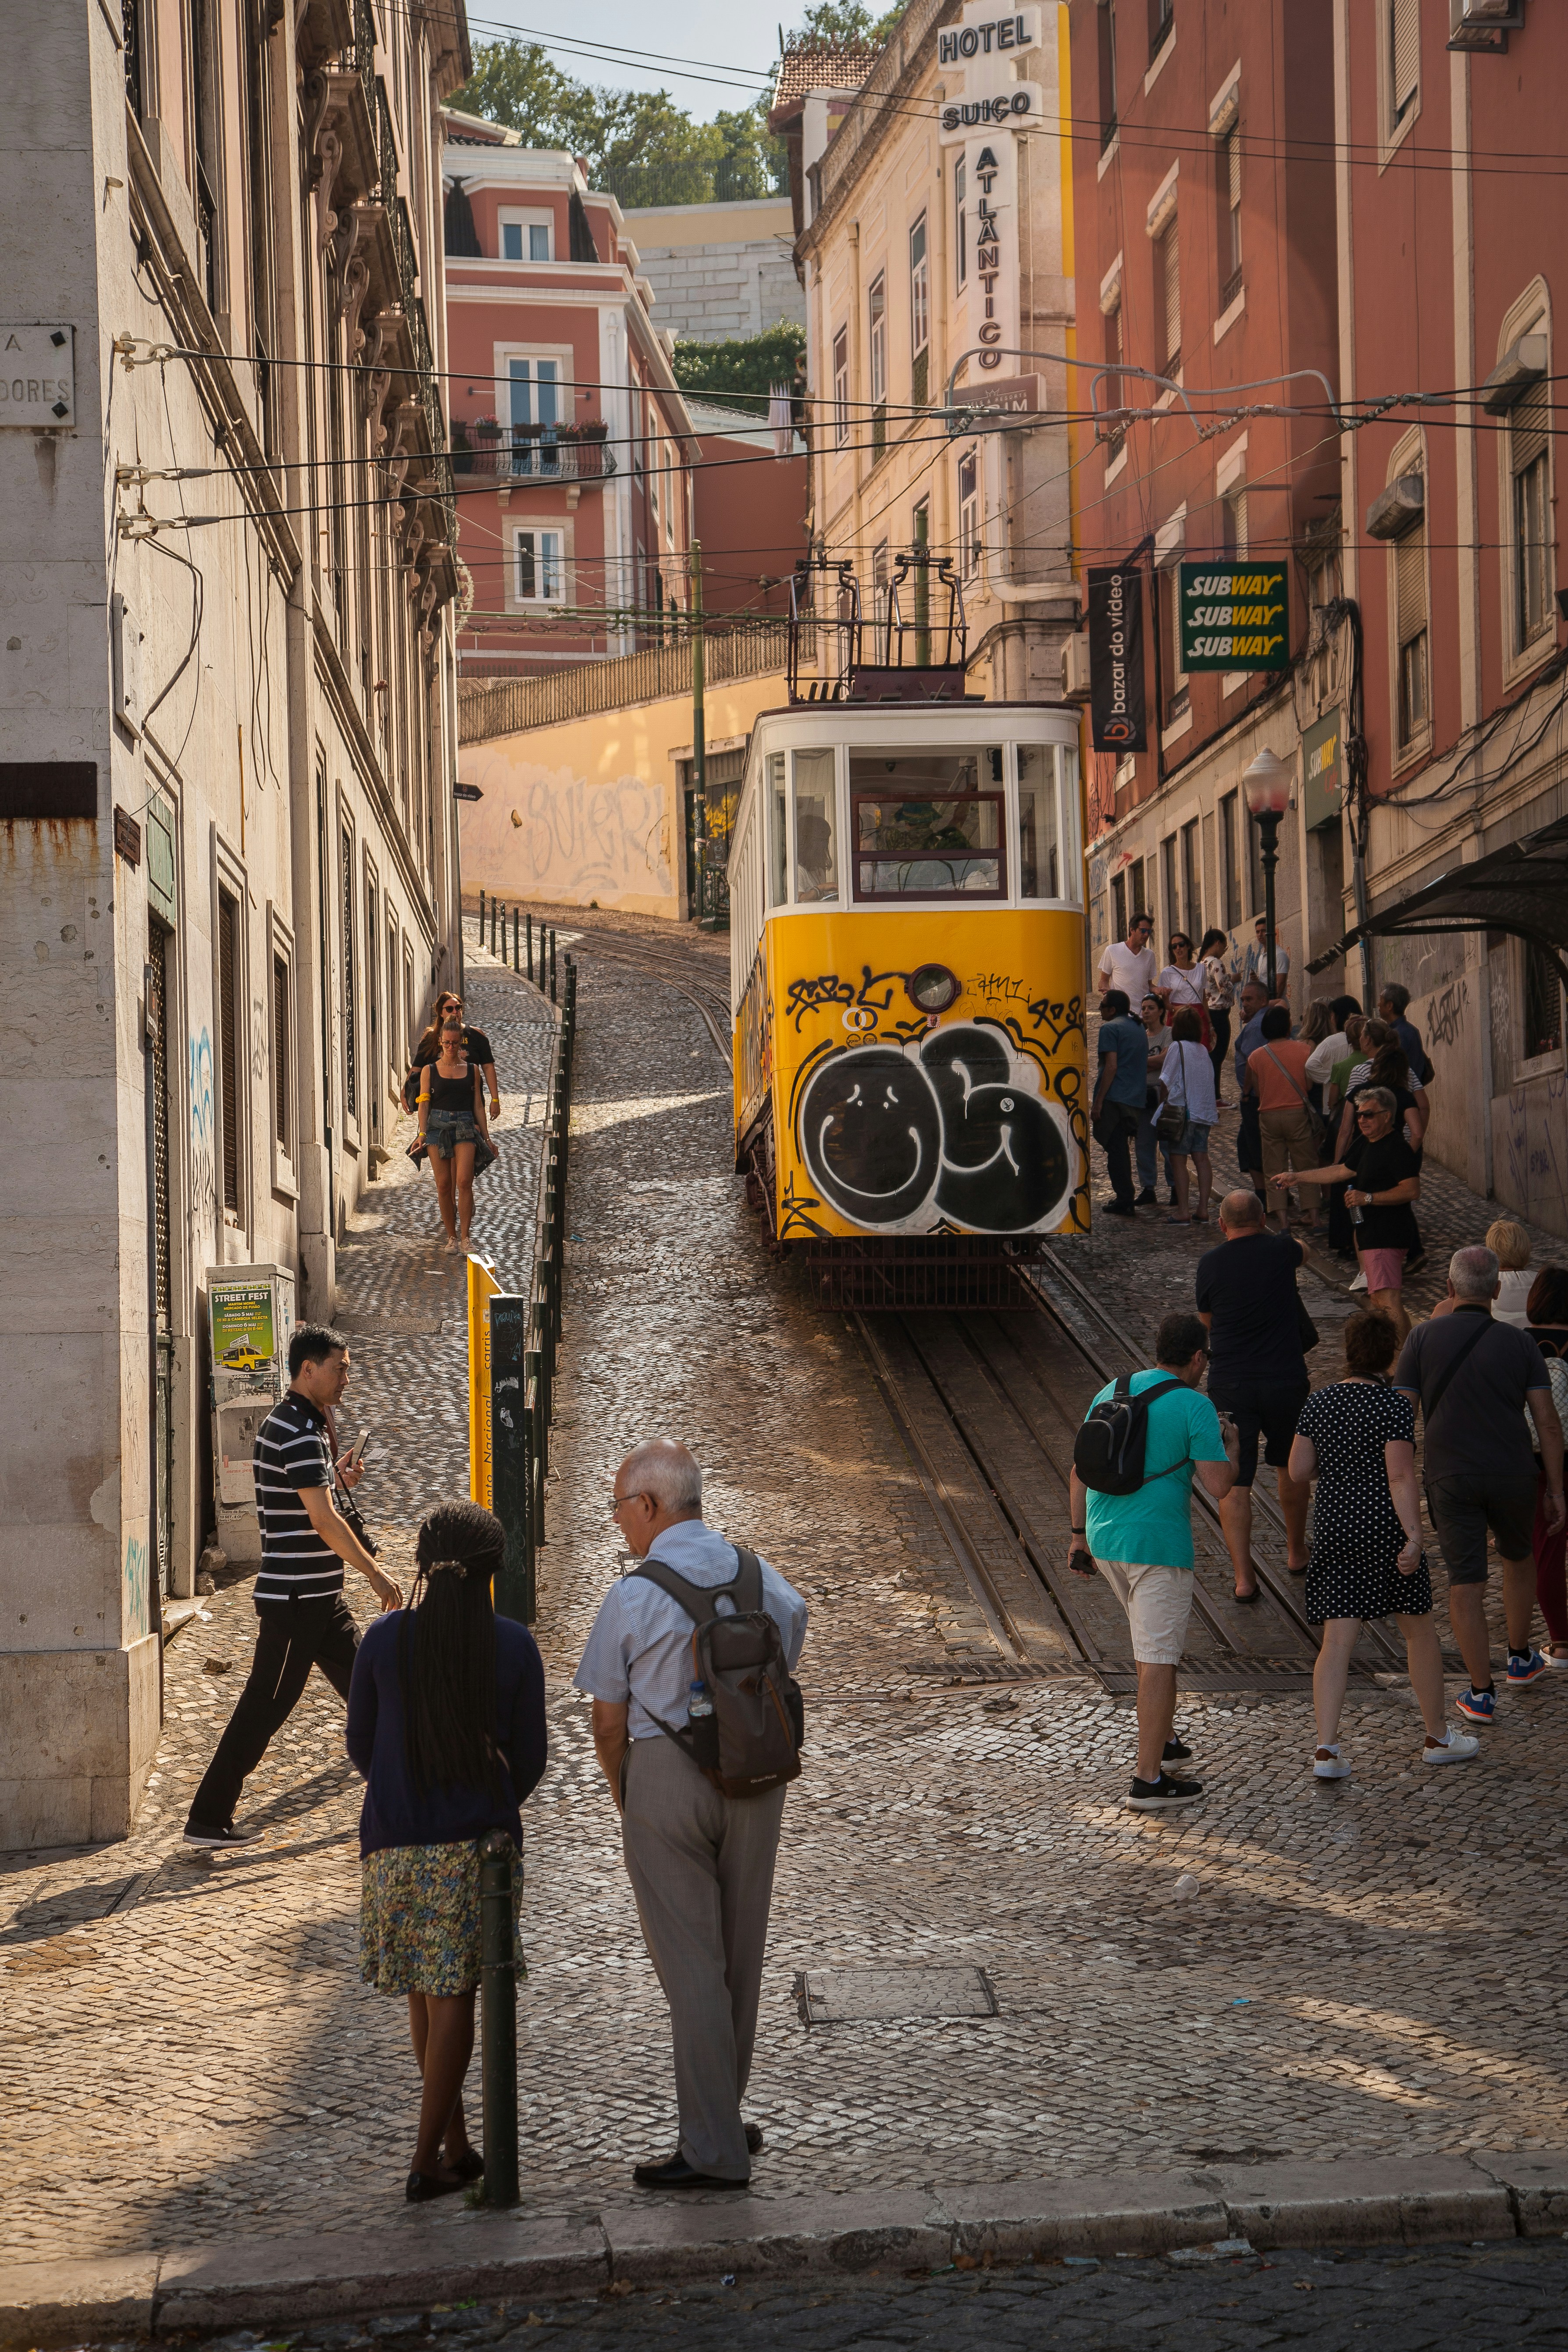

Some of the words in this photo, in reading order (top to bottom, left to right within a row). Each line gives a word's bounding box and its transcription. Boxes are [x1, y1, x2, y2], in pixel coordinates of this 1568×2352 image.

[940, 14, 1032, 64] HOTEL
[942, 91, 1031, 131] SUIÇO
[4, 334, 23, 351] A
[995, 392, 1027, 401] RESORTS
[1107, 574, 1123, 627] vídeo
[1187, 574, 1283, 597] SUBWAY
[1187, 604, 1284, 627] SUBWAY
[1109, 631, 1124, 656] do
[1187, 634, 1284, 657] SUBWAY
[1111, 660, 1126, 714] bazar
[1308, 732, 1337, 782] SUBWAY
[214, 1294, 246, 1303] STREET
[248, 1292, 268, 1301] FEST
[482, 1330, 491, 1370] carris
[482, 1395, 492, 1464] Nacional
